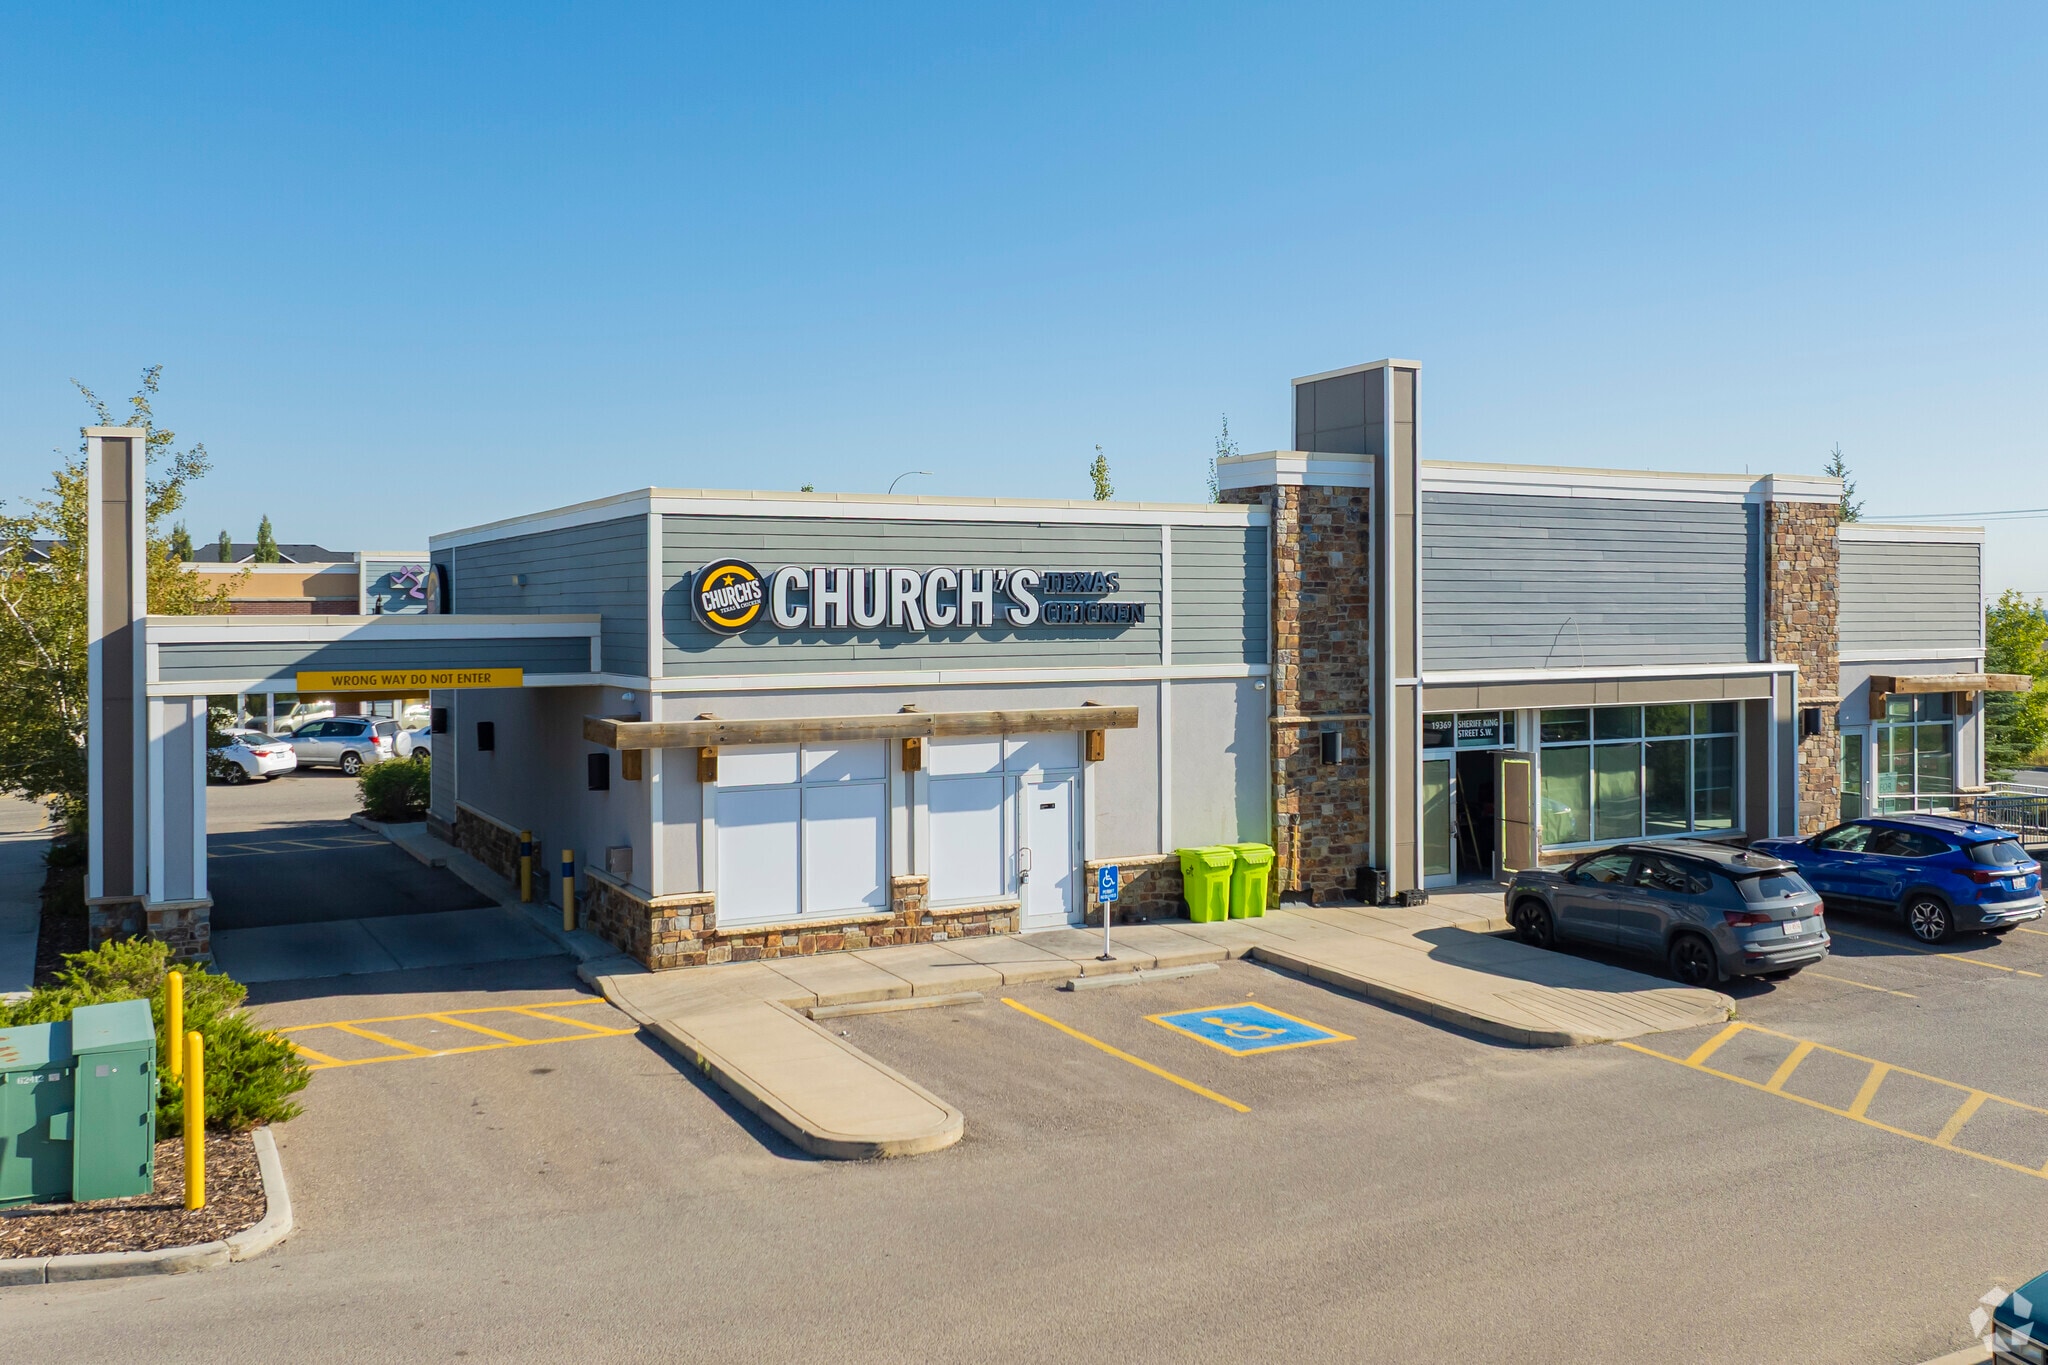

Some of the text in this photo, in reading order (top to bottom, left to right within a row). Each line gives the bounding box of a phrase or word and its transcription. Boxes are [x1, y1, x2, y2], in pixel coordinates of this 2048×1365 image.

[1043, 571, 1120, 594] TEXAS
[701, 580, 762, 611] CHURCH'S
[772, 566, 1040, 632] CHURCH'S
[720, 599, 761, 614] TEXAS CHICKEN
[1042, 601, 1146, 624] CHICKEN
[331, 672, 491, 686] WRONG WAY DO NOT ENTER
[1432, 721, 1452, 729] 19369
[1458, 719, 1498, 728] SHERIFF KING
[1458, 729, 1478, 737] STREET
